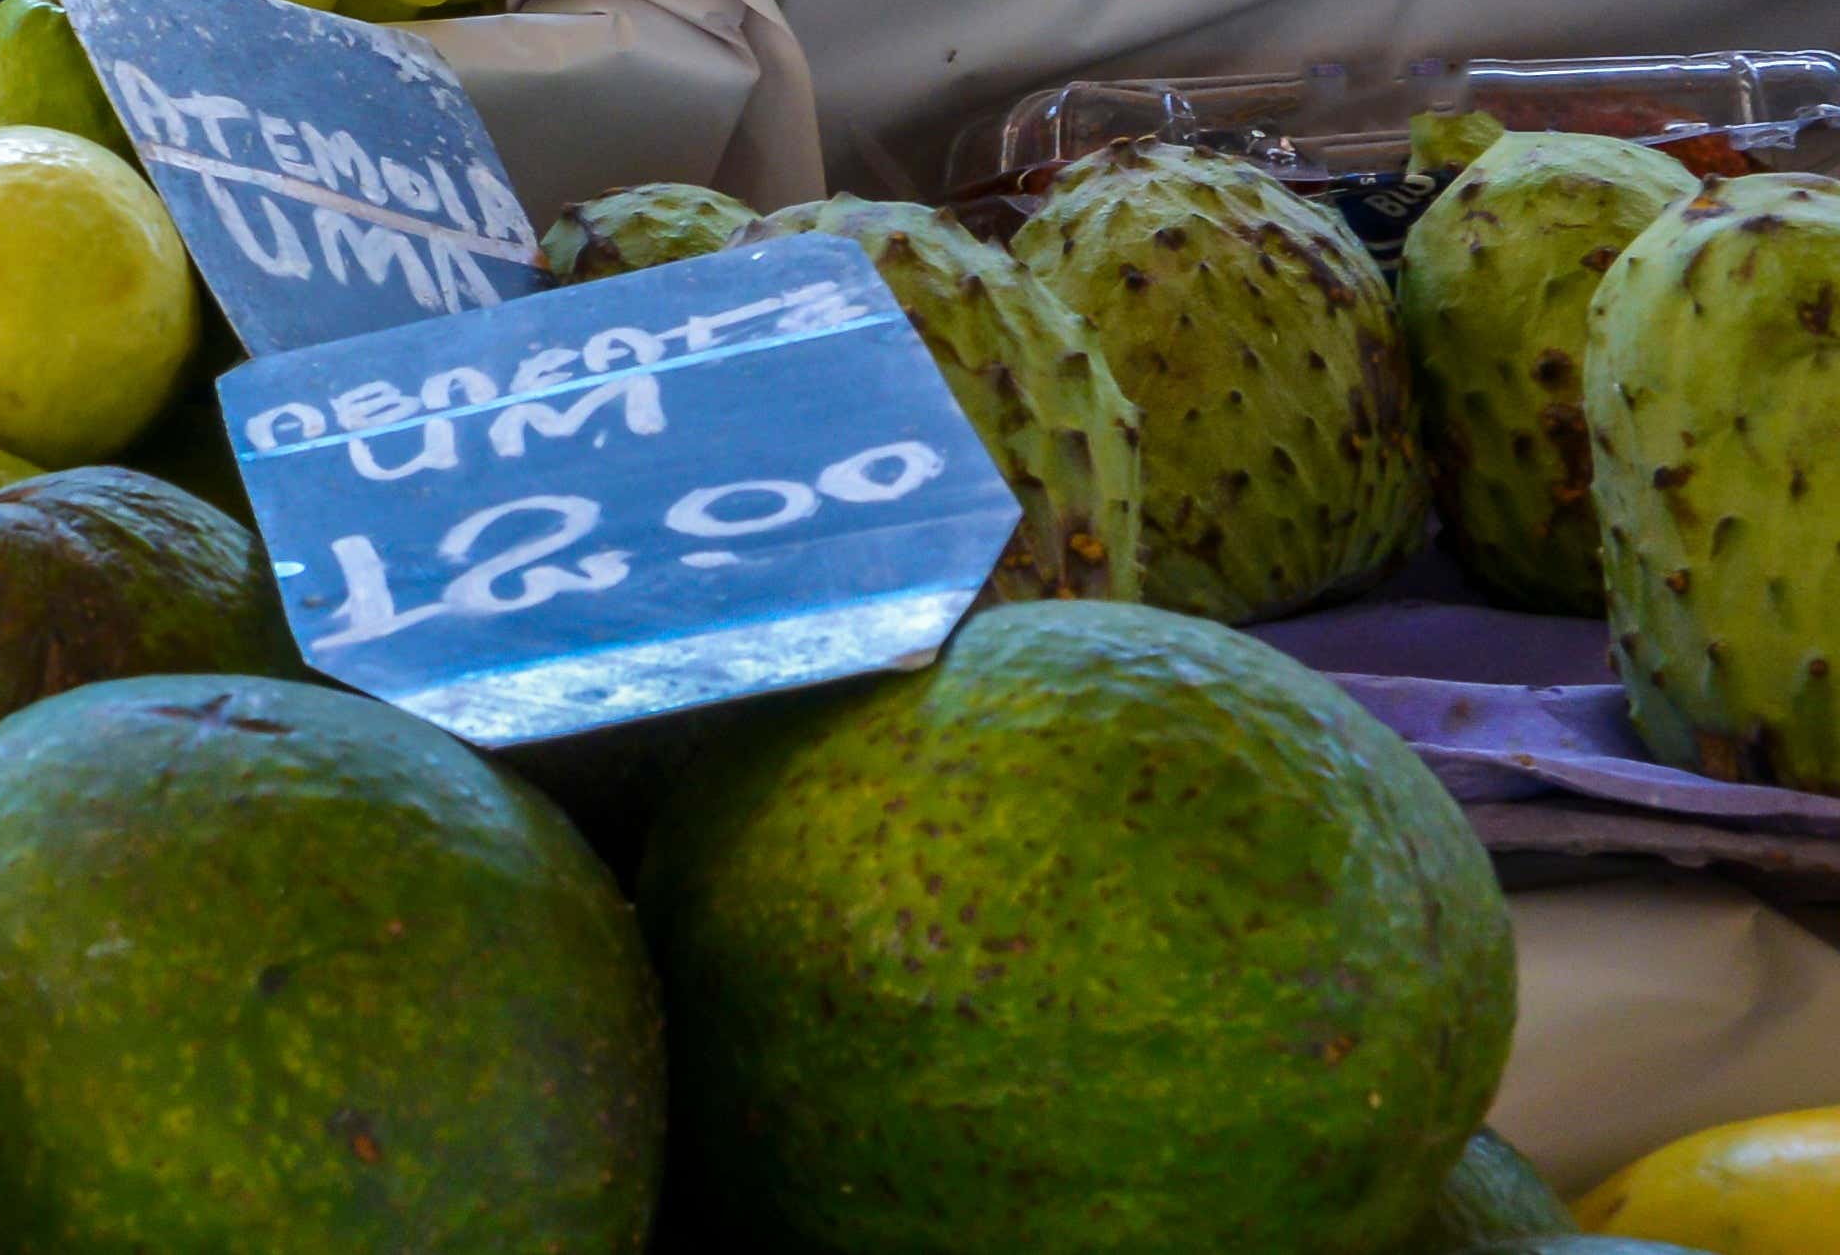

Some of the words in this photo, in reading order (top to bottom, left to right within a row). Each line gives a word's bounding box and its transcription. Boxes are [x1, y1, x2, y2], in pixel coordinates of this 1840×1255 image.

[112, 60, 539, 246] ATEMOIA
[198, 169, 504, 315] UMA
[348, 372, 668, 482] UM
[311, 441, 947, 651] 12.00
